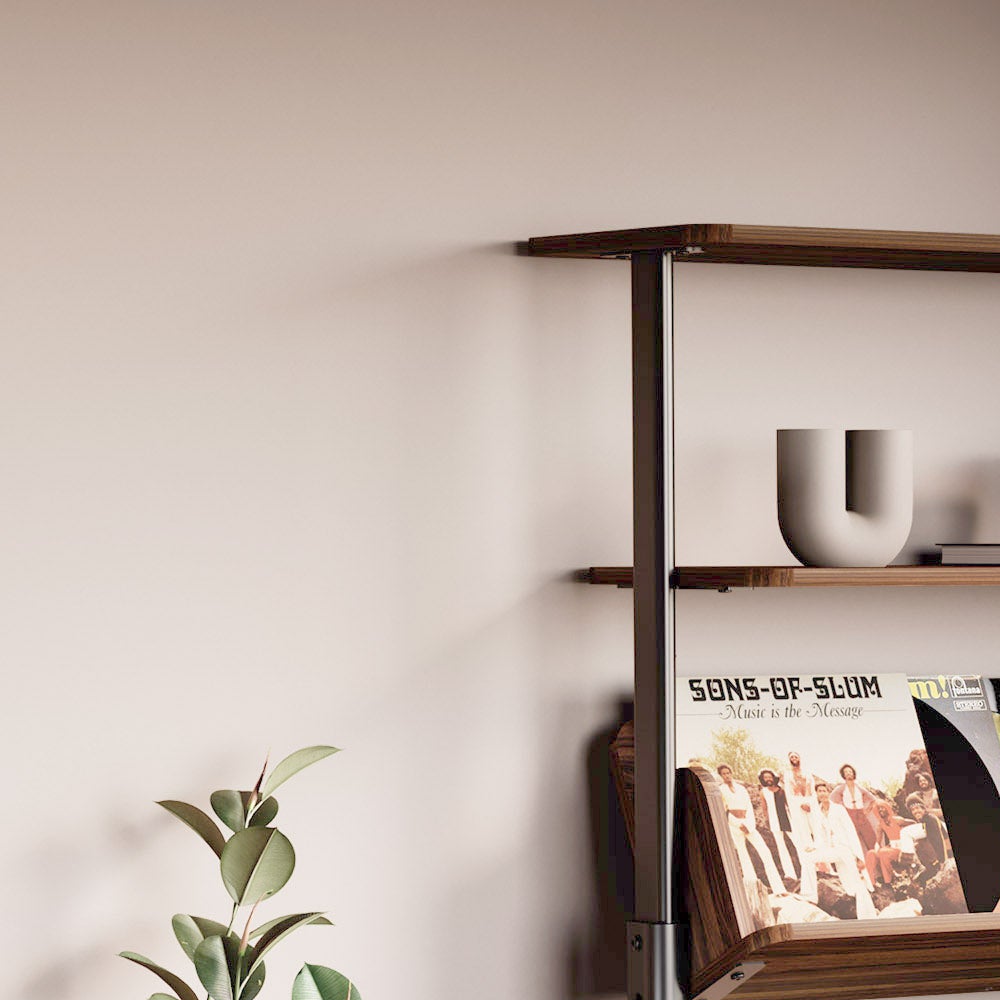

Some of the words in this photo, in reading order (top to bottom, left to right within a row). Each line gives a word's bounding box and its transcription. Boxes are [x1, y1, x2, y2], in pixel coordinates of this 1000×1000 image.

[688, 676, 882, 701] SONS-OF-SLUM
[719, 703, 766, 719] Music
[771, 703, 780, 718] is
[785, 703, 802, 718] the
[806, 702, 863, 720] Message
